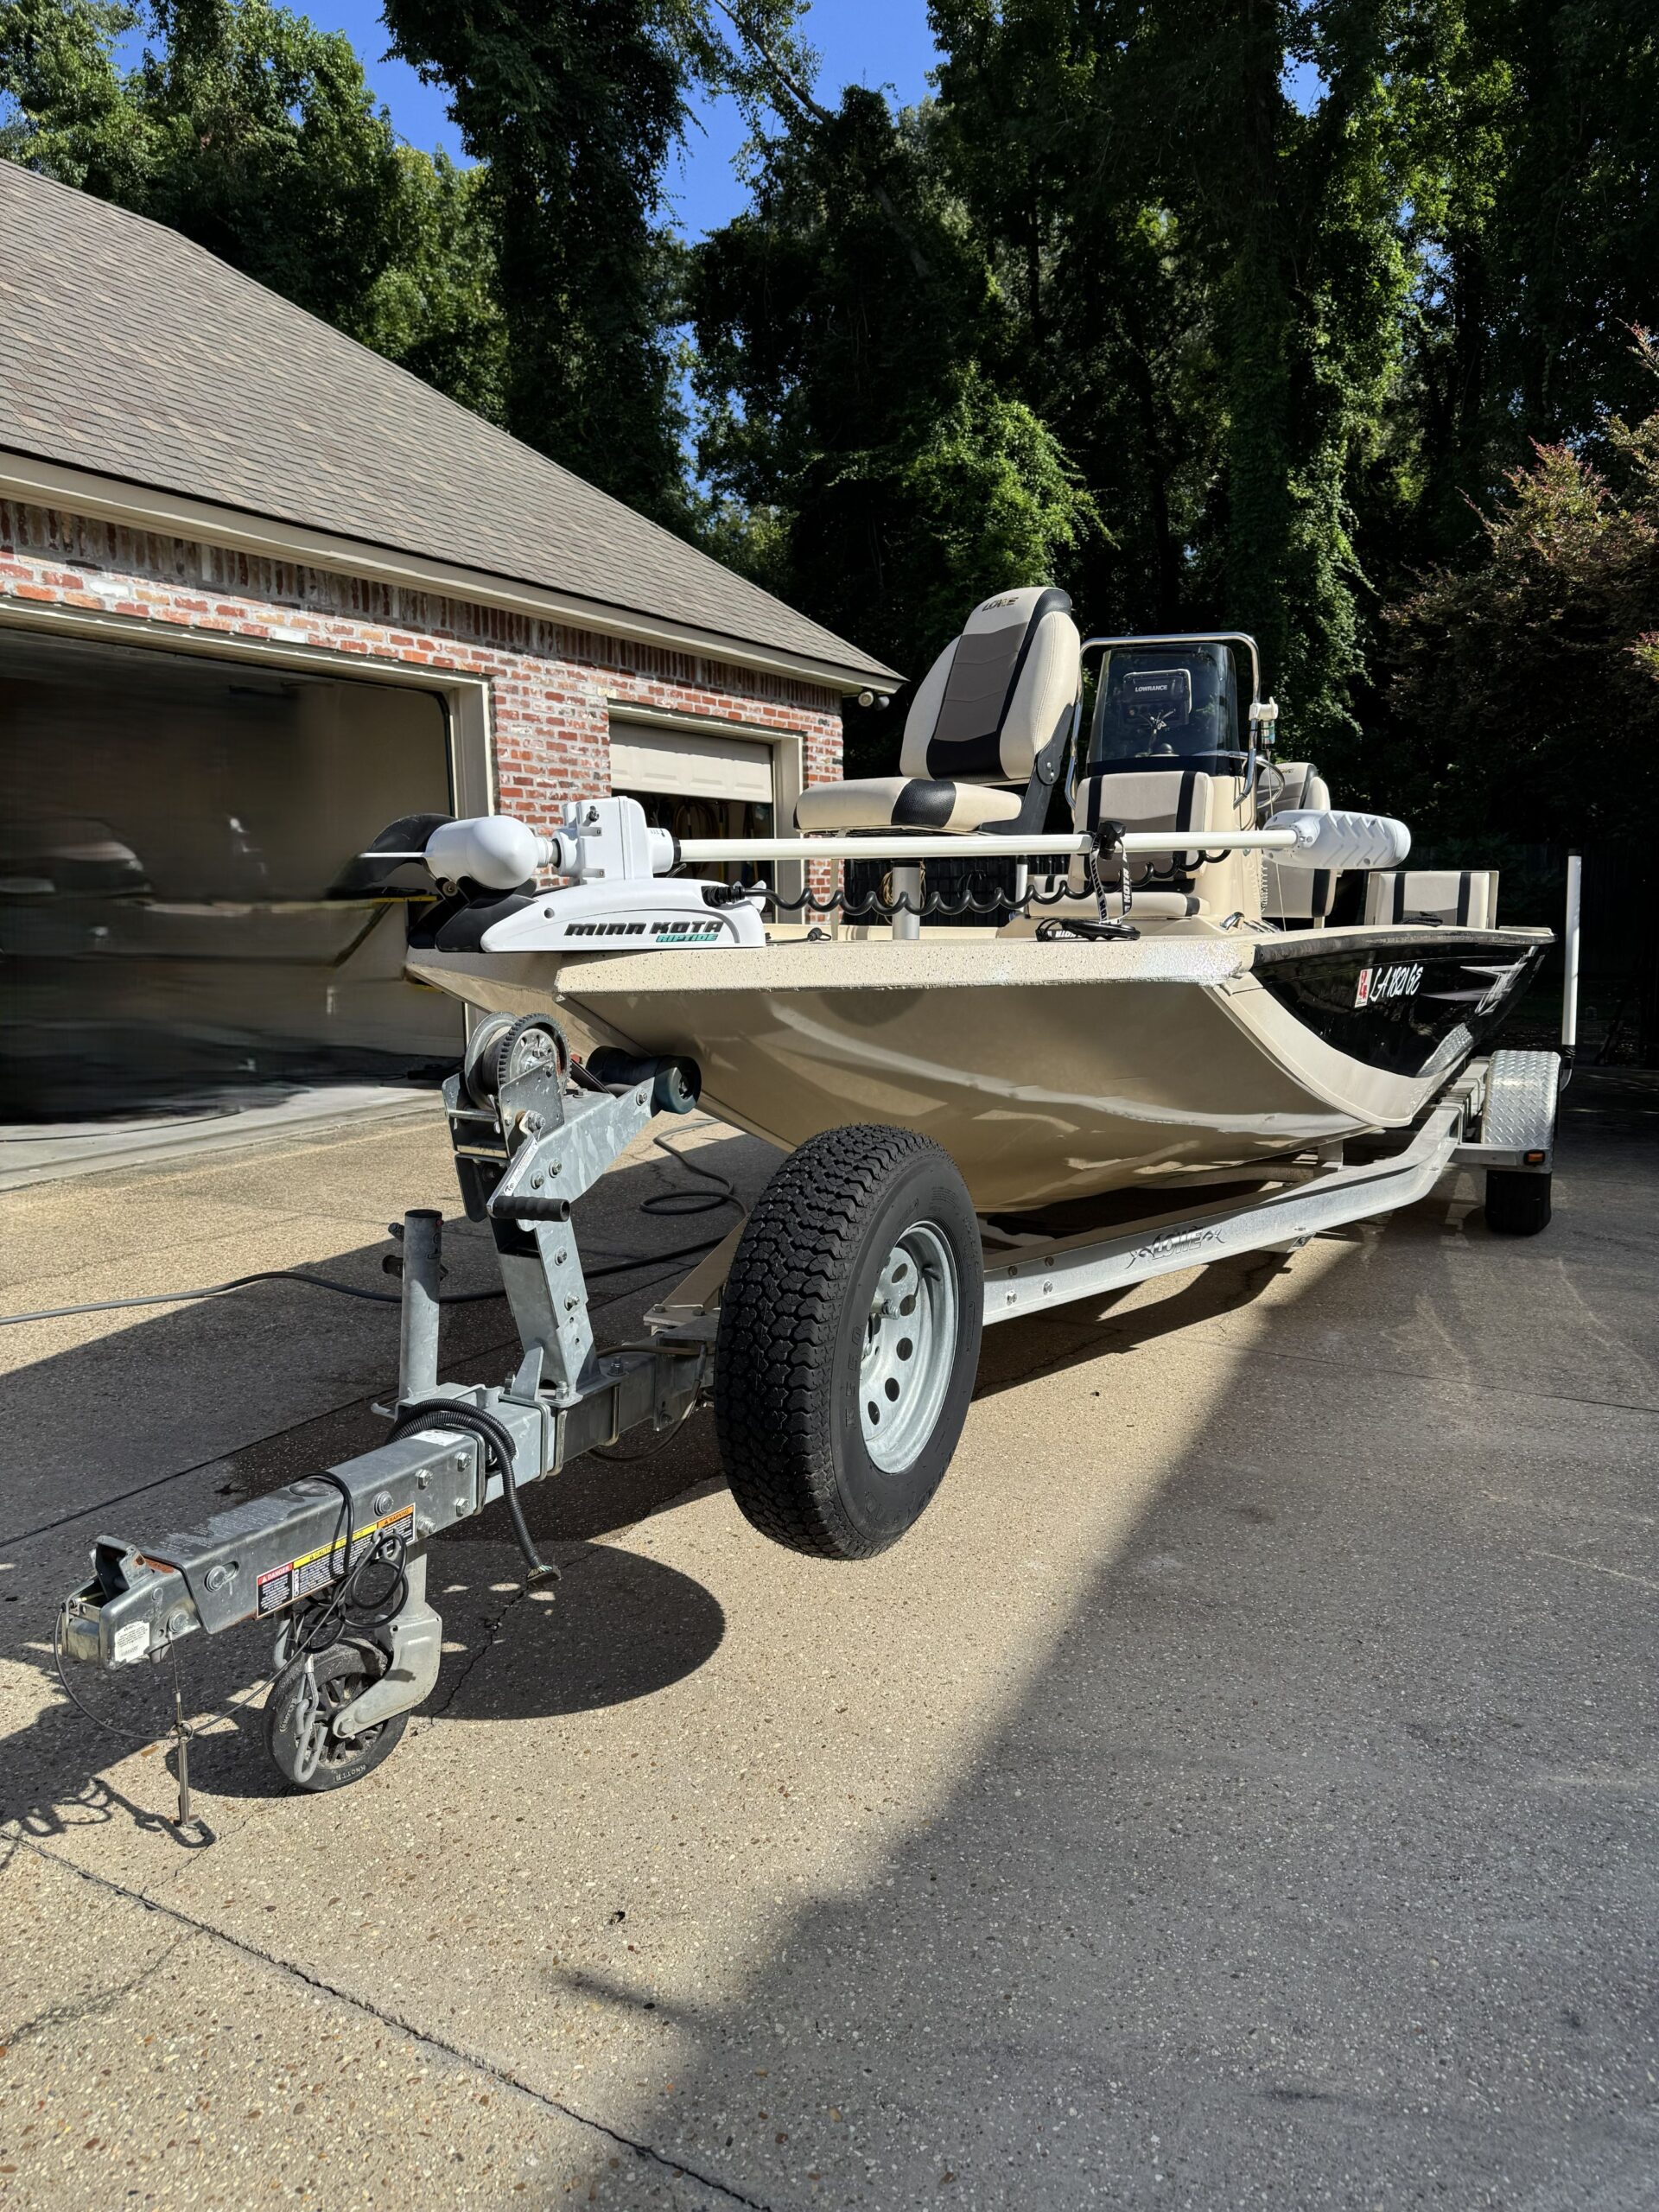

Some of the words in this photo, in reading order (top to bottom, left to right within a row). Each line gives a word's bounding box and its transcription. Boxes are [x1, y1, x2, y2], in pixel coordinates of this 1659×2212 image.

[982, 596, 1020, 613] LOWE
[1135, 684, 1168, 693] LOWRANCE
[564, 922, 646, 936] MINN
[648, 920, 724, 934] KOTA
[656, 933, 719, 943] RIPTIDE
[267, 1564, 289, 1580] DANGER
